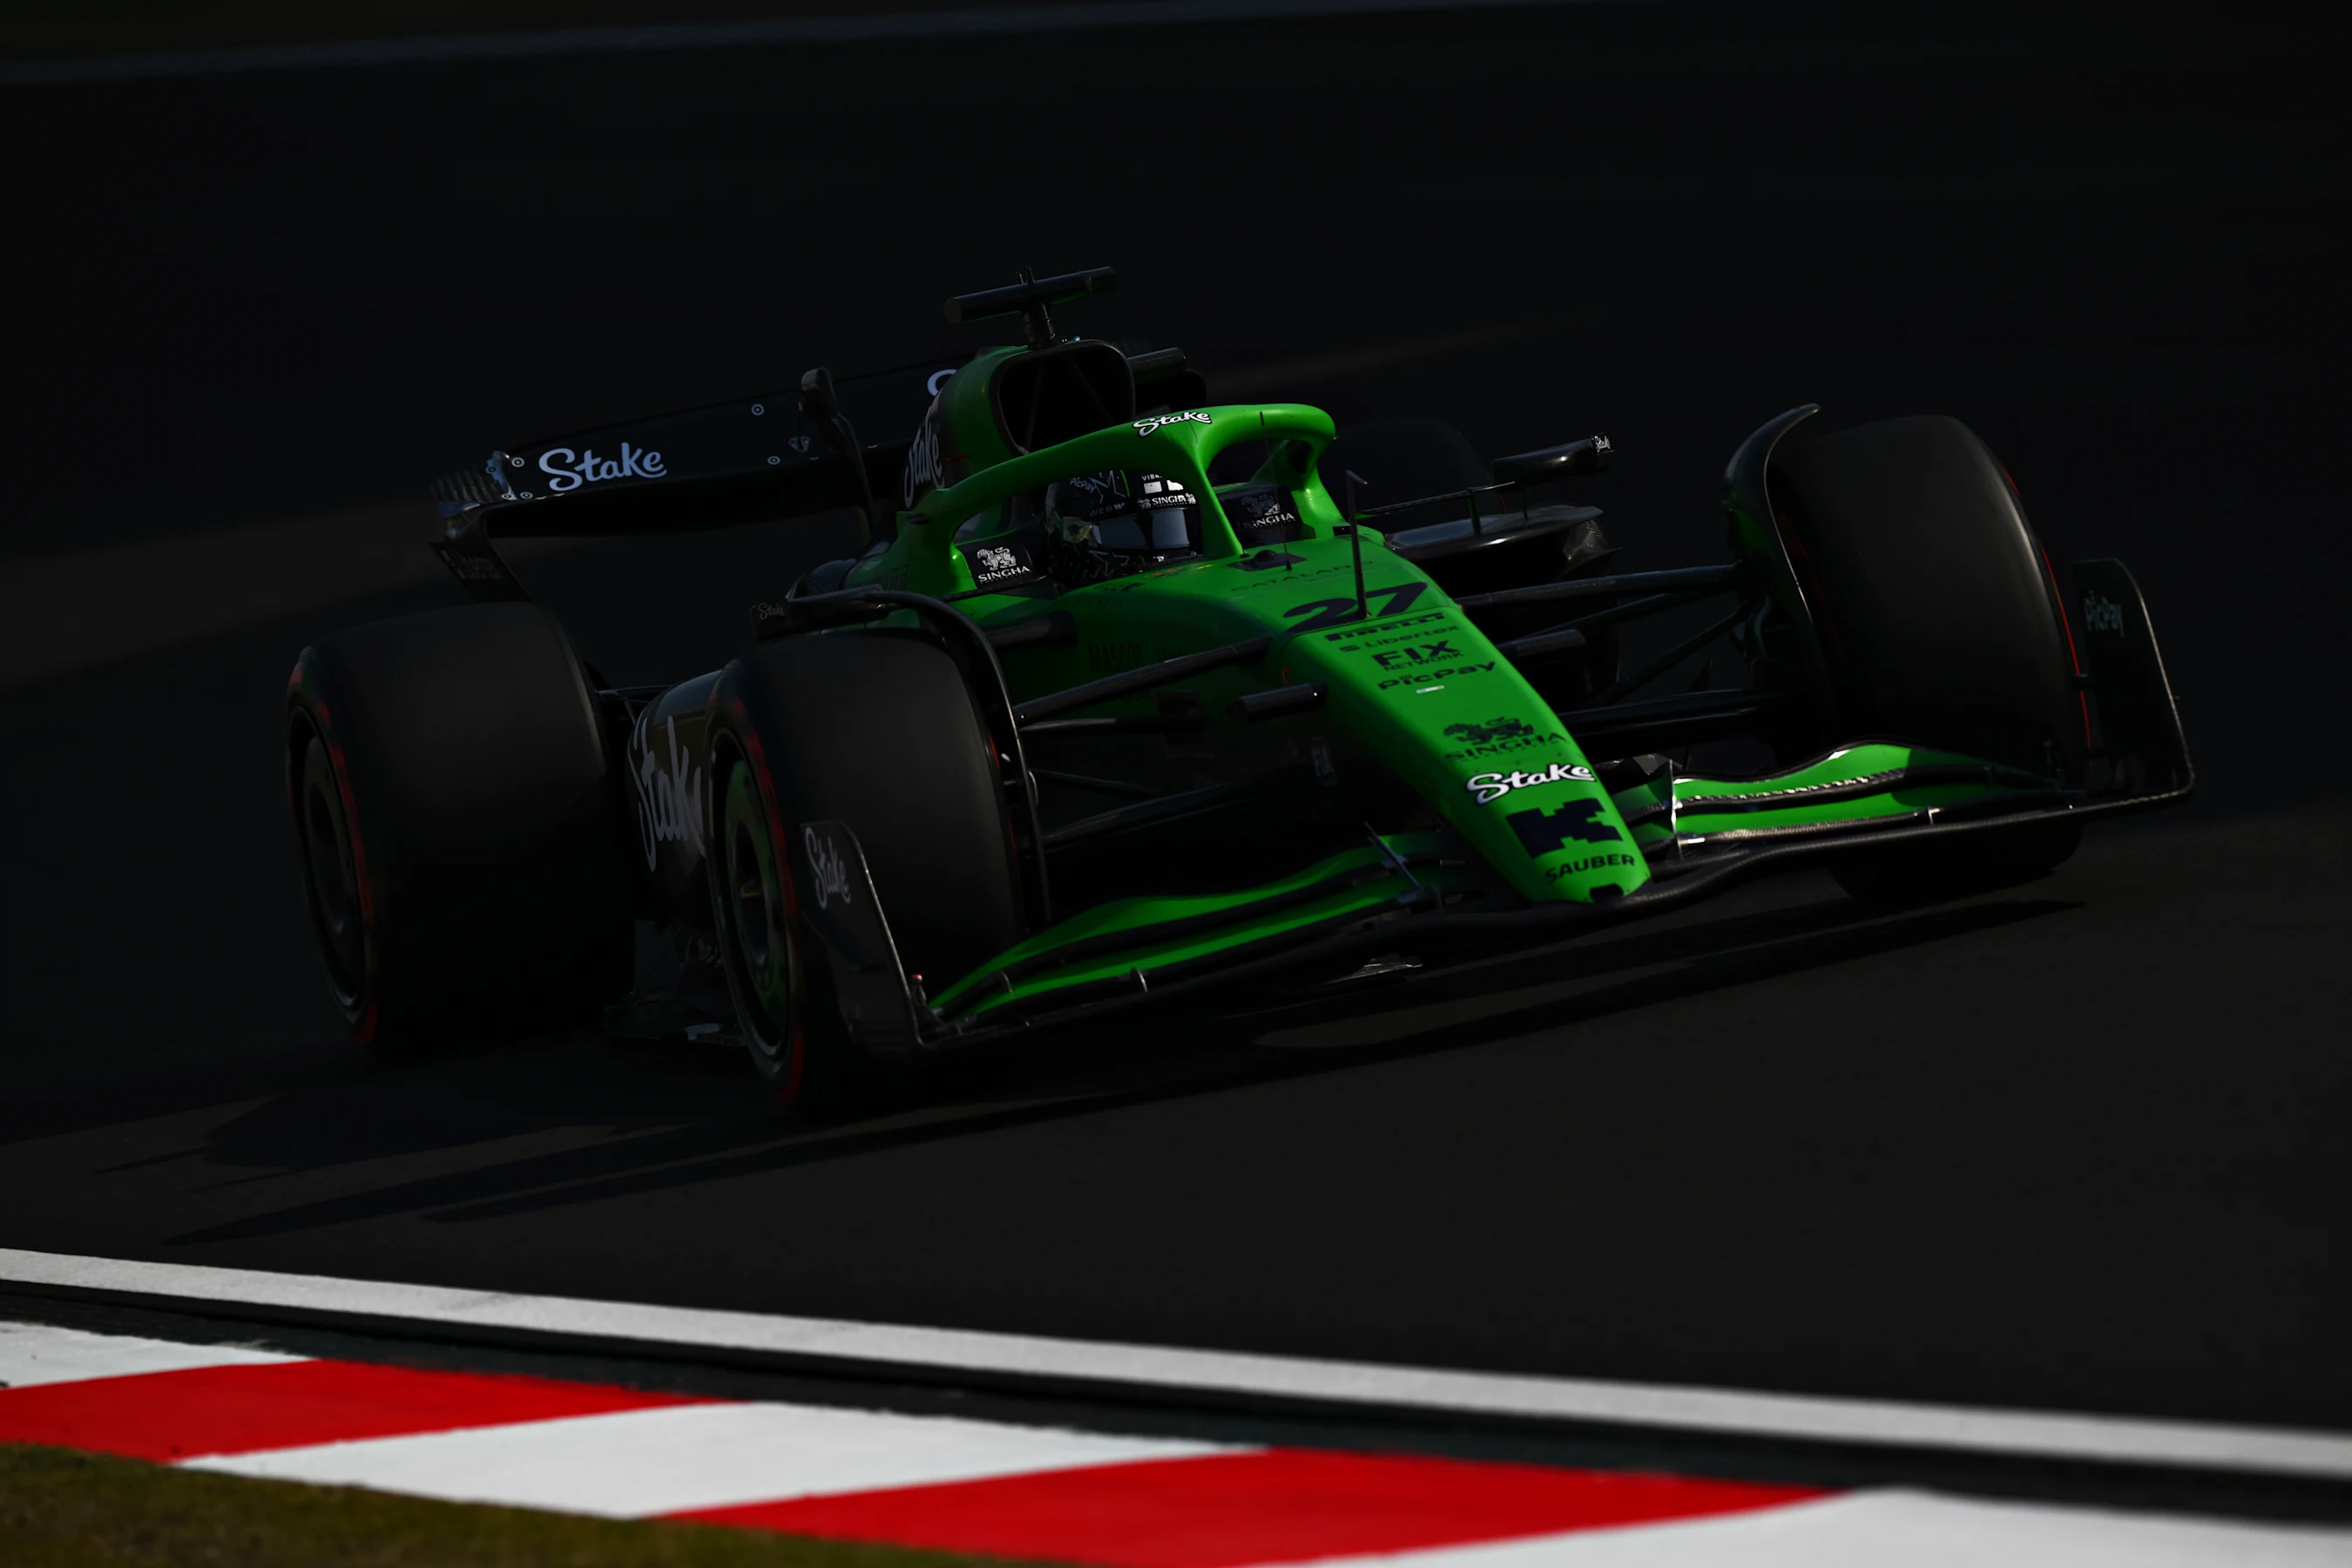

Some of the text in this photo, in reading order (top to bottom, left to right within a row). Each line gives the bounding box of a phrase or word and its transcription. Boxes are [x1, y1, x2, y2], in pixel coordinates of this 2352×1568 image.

[1132, 412, 1213, 437] Stake
[538, 442, 667, 492] Stake
[1069, 476, 1096, 494] PicPay
[1152, 494, 1186, 506] SINGHA
[1243, 512, 1295, 530] SINGHA
[977, 564, 1031, 583] SINGHA
[1282, 582, 1429, 633] 27
[2084, 589, 2126, 639] PicPay
[1365, 625, 1460, 648] Libertex
[1372, 640, 1460, 666] FIX
[1383, 652, 1464, 672] NETWORK
[1377, 661, 1496, 689] PicPay
[1444, 733, 1567, 760] SINGHA
[1466, 763, 1596, 806] Stake
[804, 826, 852, 910] Stake
[1544, 854, 1636, 885] SAUBER
